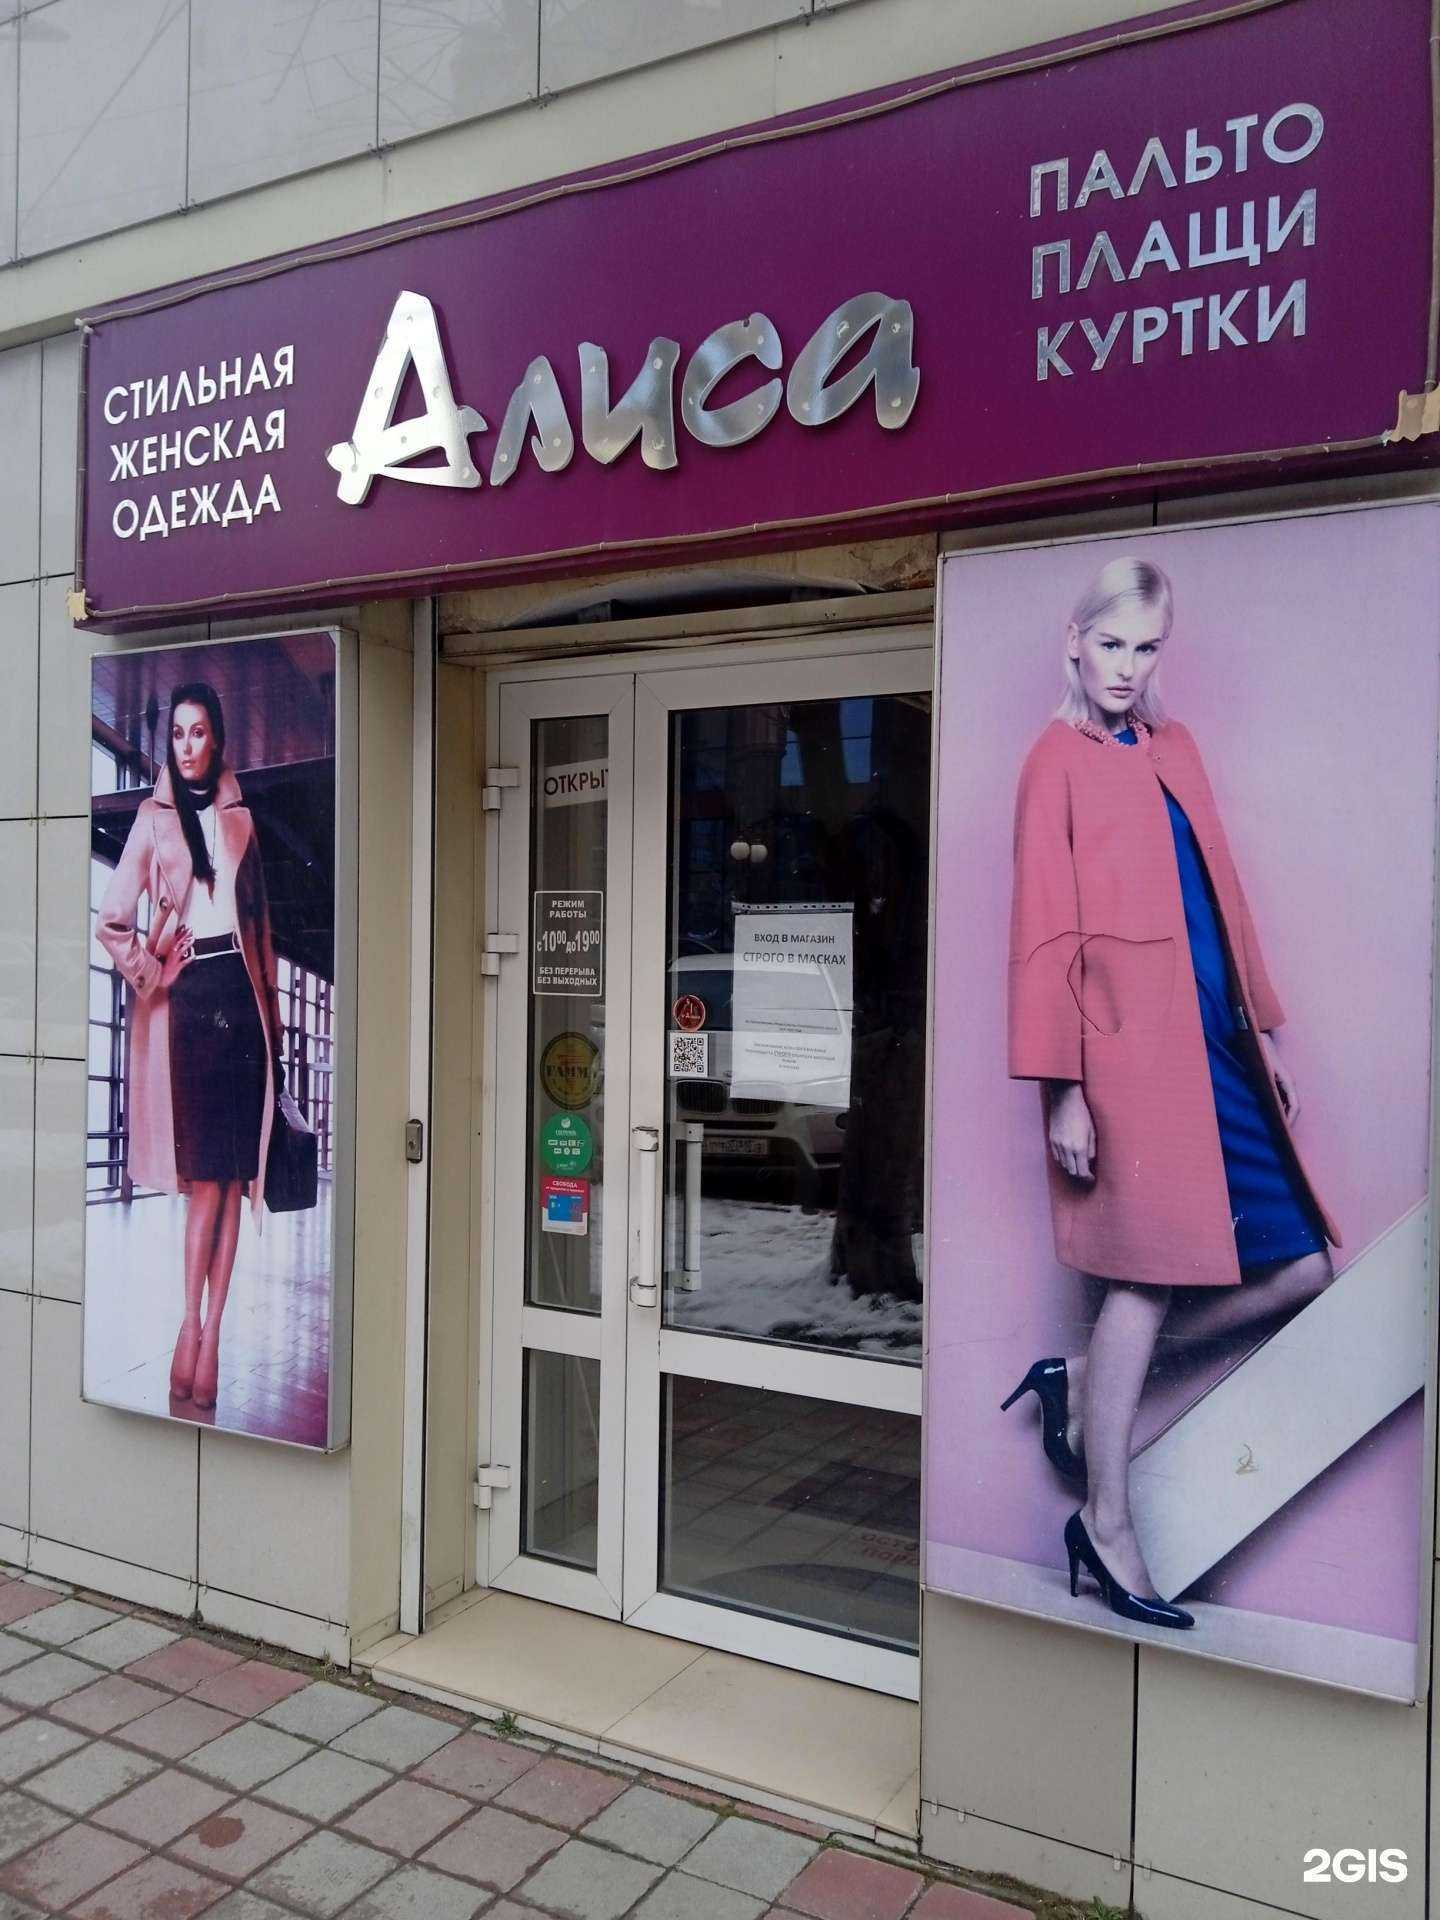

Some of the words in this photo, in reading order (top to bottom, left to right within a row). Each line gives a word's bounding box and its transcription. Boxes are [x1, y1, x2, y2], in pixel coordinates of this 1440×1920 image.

[1030, 102, 1324, 218] ПАЛЬТО
[1031, 188, 1317, 299] ПЛАЩИ
[1037, 278, 1307, 381] КУРТКИ
[103, 345, 295, 425] СТИЛЬНАЯ
[326, 290, 921, 505] Алиса
[109, 408, 286, 482] ЖЕНСКАЯ
[112, 473, 282, 541] ОДЕЖДА
[549, 910, 587, 919] РАБОТЫ
[551, 900, 585, 909] РЕЖИМ
[539, 966, 553, 975] БЕЗ
[555, 967, 596, 976] ПЕРЕРЫВА
[743, 952, 785, 964] СТРОГО
[788, 953, 795, 964] В
[798, 953, 847, 965] МАСКАХ
[754, 933, 780, 944] ВХОД
[781, 934, 788, 943] В
[790, 934, 835, 945] МАГАЗИН
[537, 976, 551, 985] БЕЗ
[553, 977, 598, 986] ВЫХОДНЫХ
